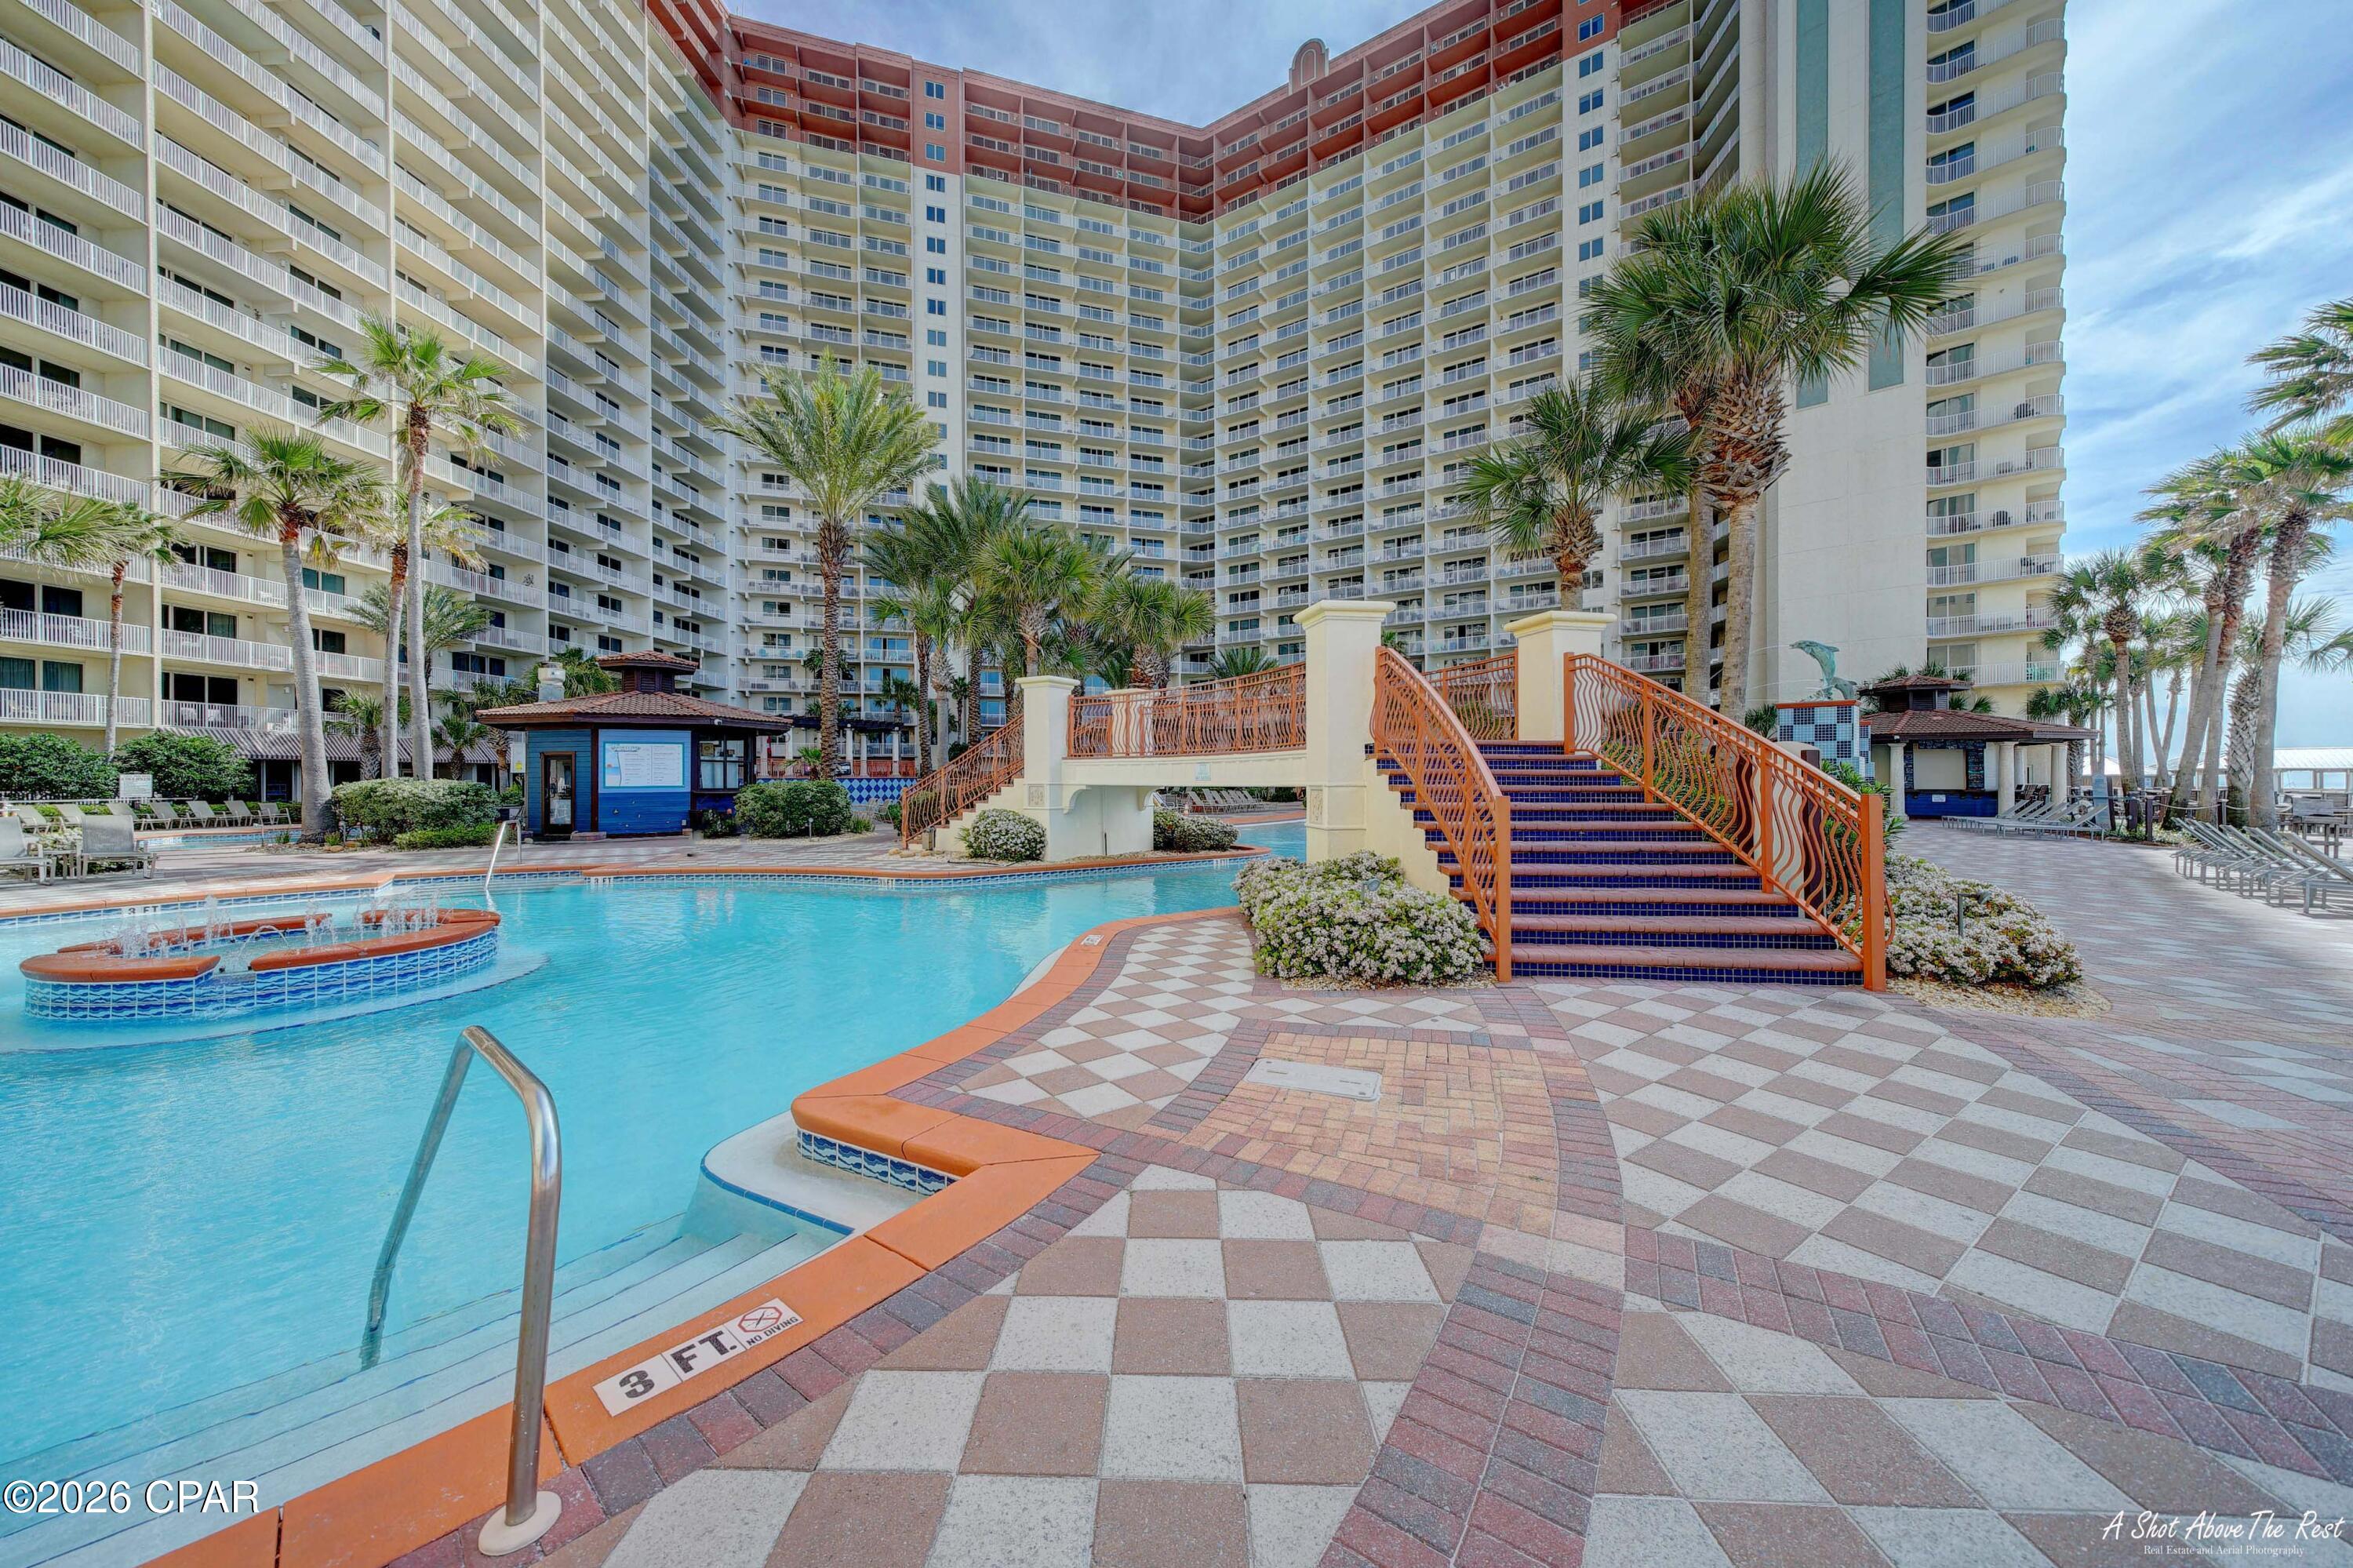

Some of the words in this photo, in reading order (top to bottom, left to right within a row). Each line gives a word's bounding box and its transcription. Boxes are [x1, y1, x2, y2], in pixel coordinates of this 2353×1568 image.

[746, 1334, 763, 1347] NO
[764, 1316, 798, 1337] DIVING
[618, 1370, 656, 1399] 3
[670, 1330, 738, 1373] FT.
